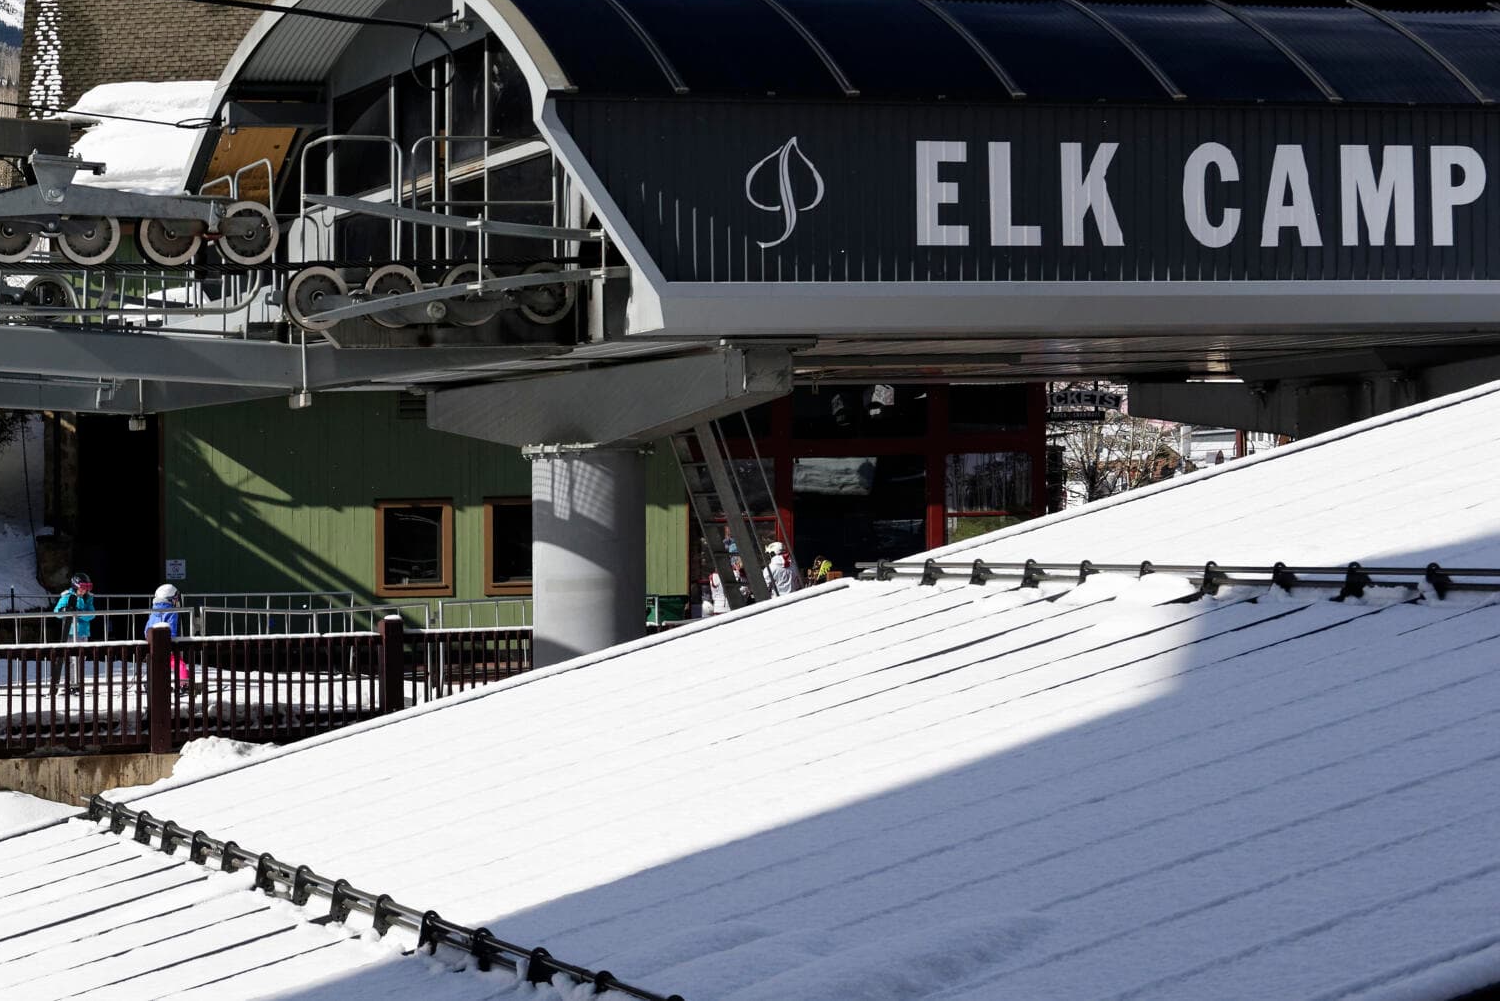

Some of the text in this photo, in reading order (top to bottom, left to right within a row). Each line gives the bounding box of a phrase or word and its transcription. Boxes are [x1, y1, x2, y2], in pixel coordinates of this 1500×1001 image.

[915, 140, 1487, 248] ELK CAMP
[1046, 391, 1117, 407] ICKETS
